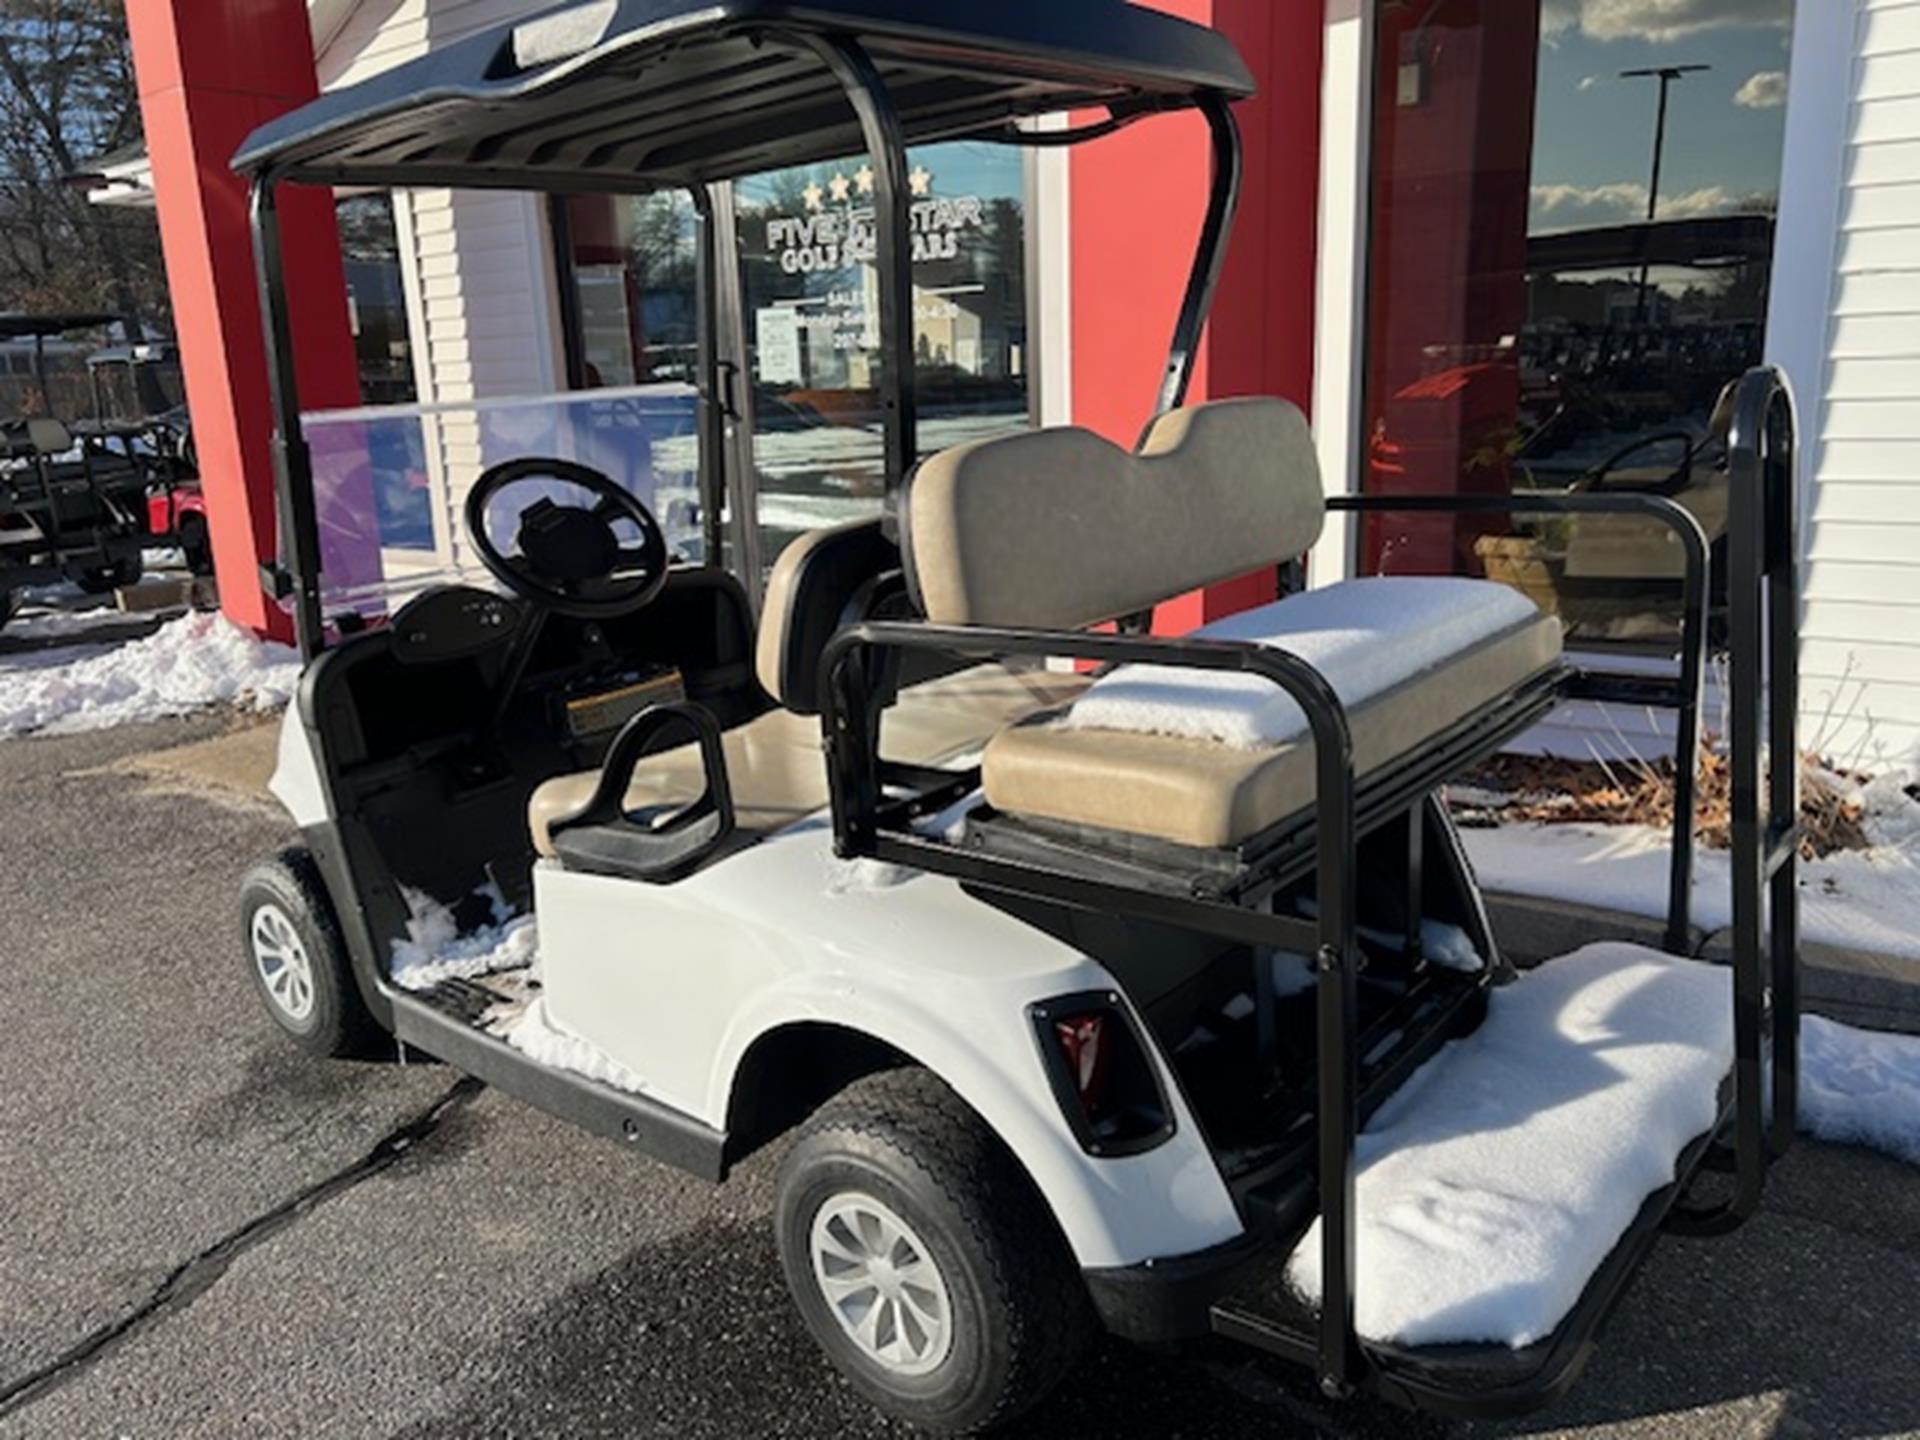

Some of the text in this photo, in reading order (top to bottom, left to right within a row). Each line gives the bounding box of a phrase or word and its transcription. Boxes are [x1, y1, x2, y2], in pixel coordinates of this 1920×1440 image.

[767, 213, 838, 249] FIVE
[780, 231, 957, 273] GOLF ARS
